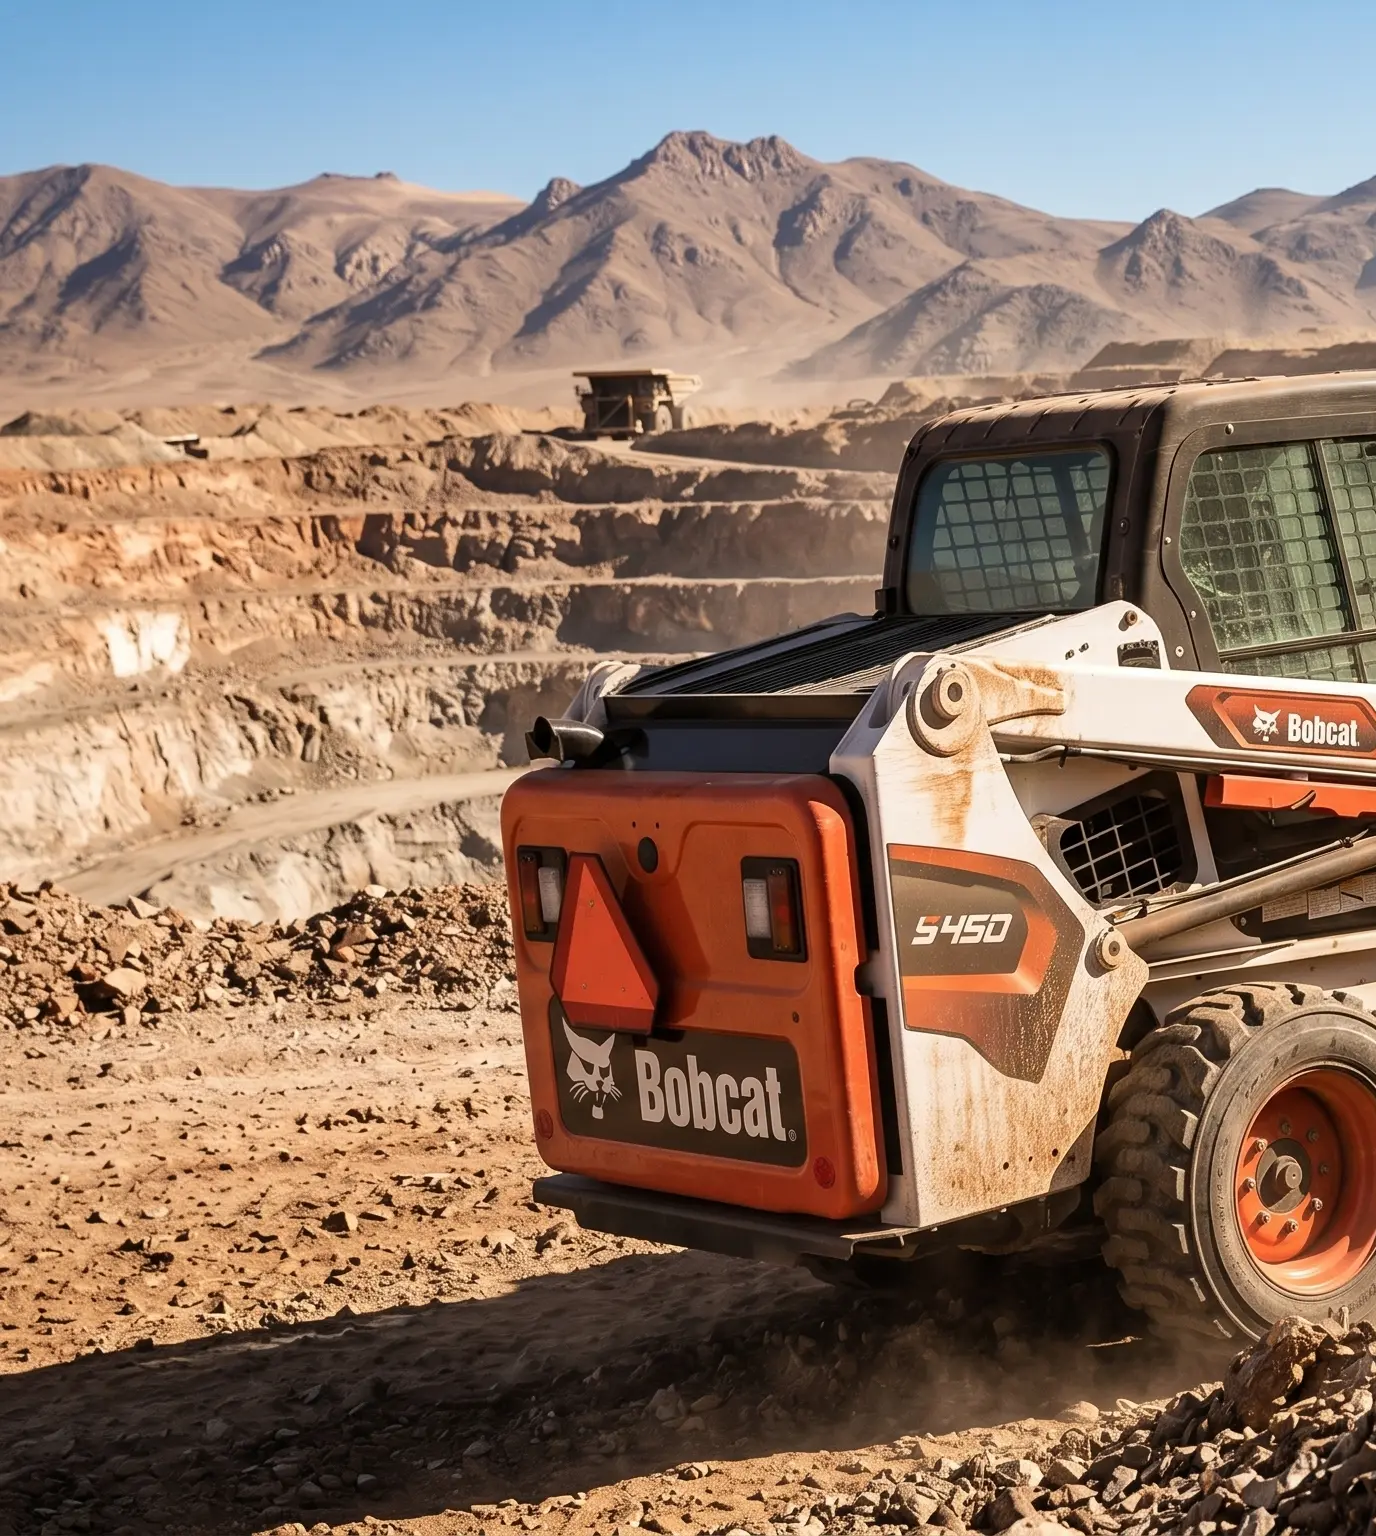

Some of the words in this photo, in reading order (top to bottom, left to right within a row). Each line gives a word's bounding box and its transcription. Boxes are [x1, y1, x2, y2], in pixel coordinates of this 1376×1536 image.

[1287, 713, 1358, 747] Bobcat
[910, 913, 1013, 946] S450
[634, 1049, 787, 1142] Bobcat
